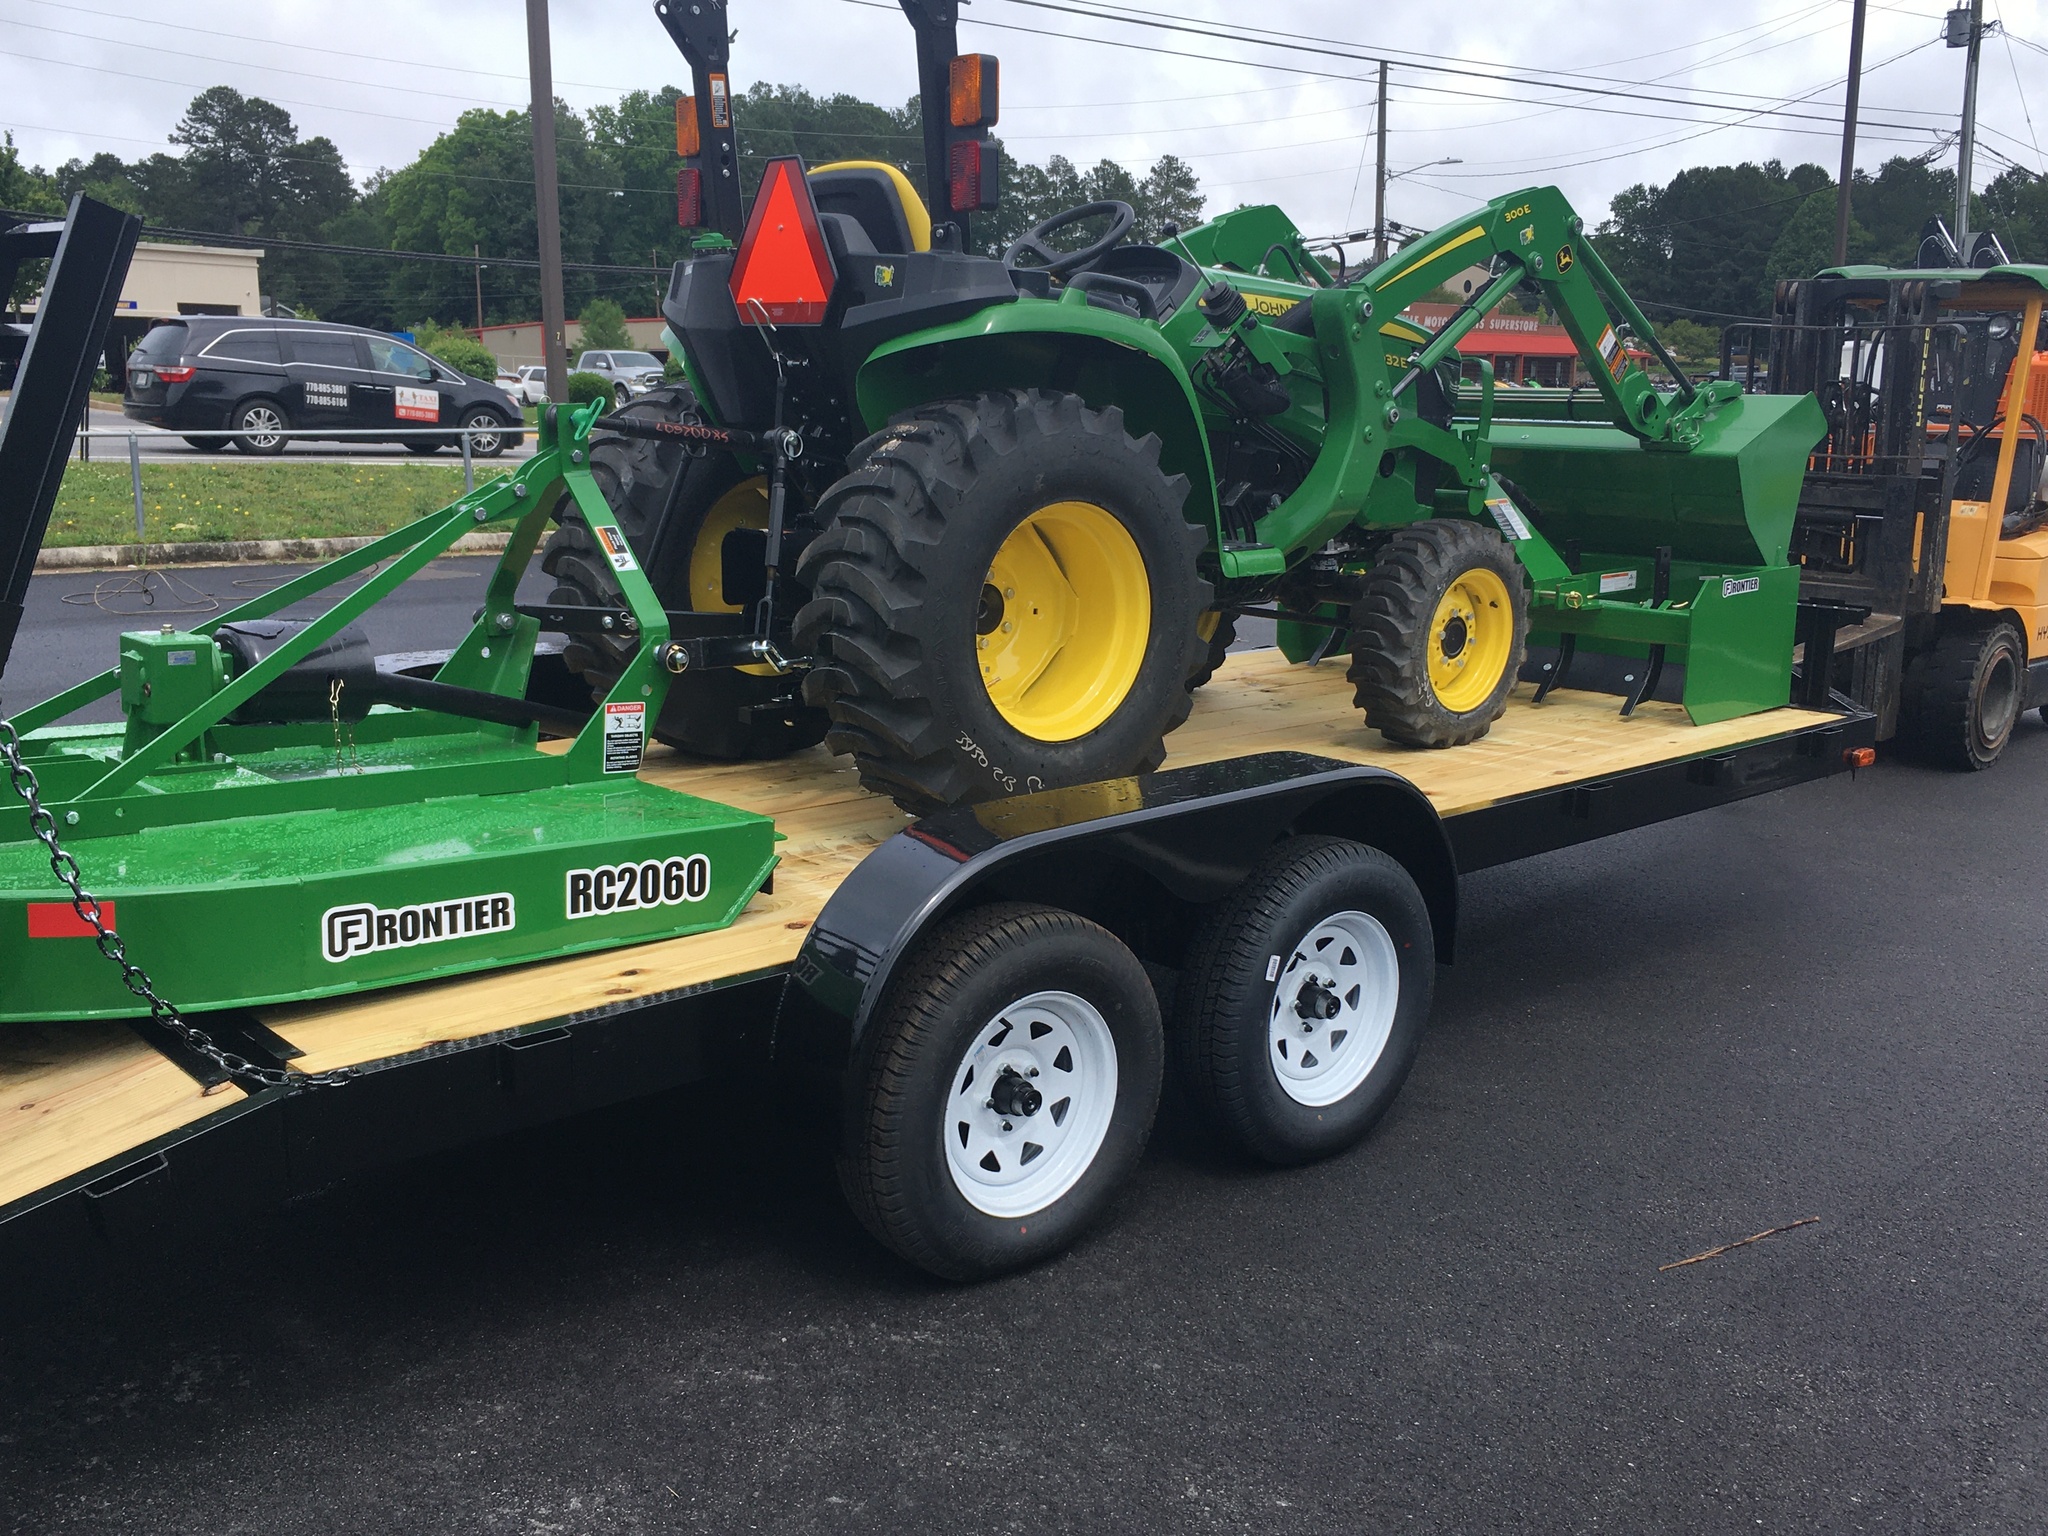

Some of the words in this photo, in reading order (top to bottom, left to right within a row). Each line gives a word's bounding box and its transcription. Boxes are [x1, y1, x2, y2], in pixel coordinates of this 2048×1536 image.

[1489, 319, 1539, 331] SUPERSTORE
[1384, 354, 1408, 369] 32E
[1724, 578, 1758, 596] FRONTIER
[571, 858, 707, 914] RC2060
[328, 897, 511, 957] FRONTIER
